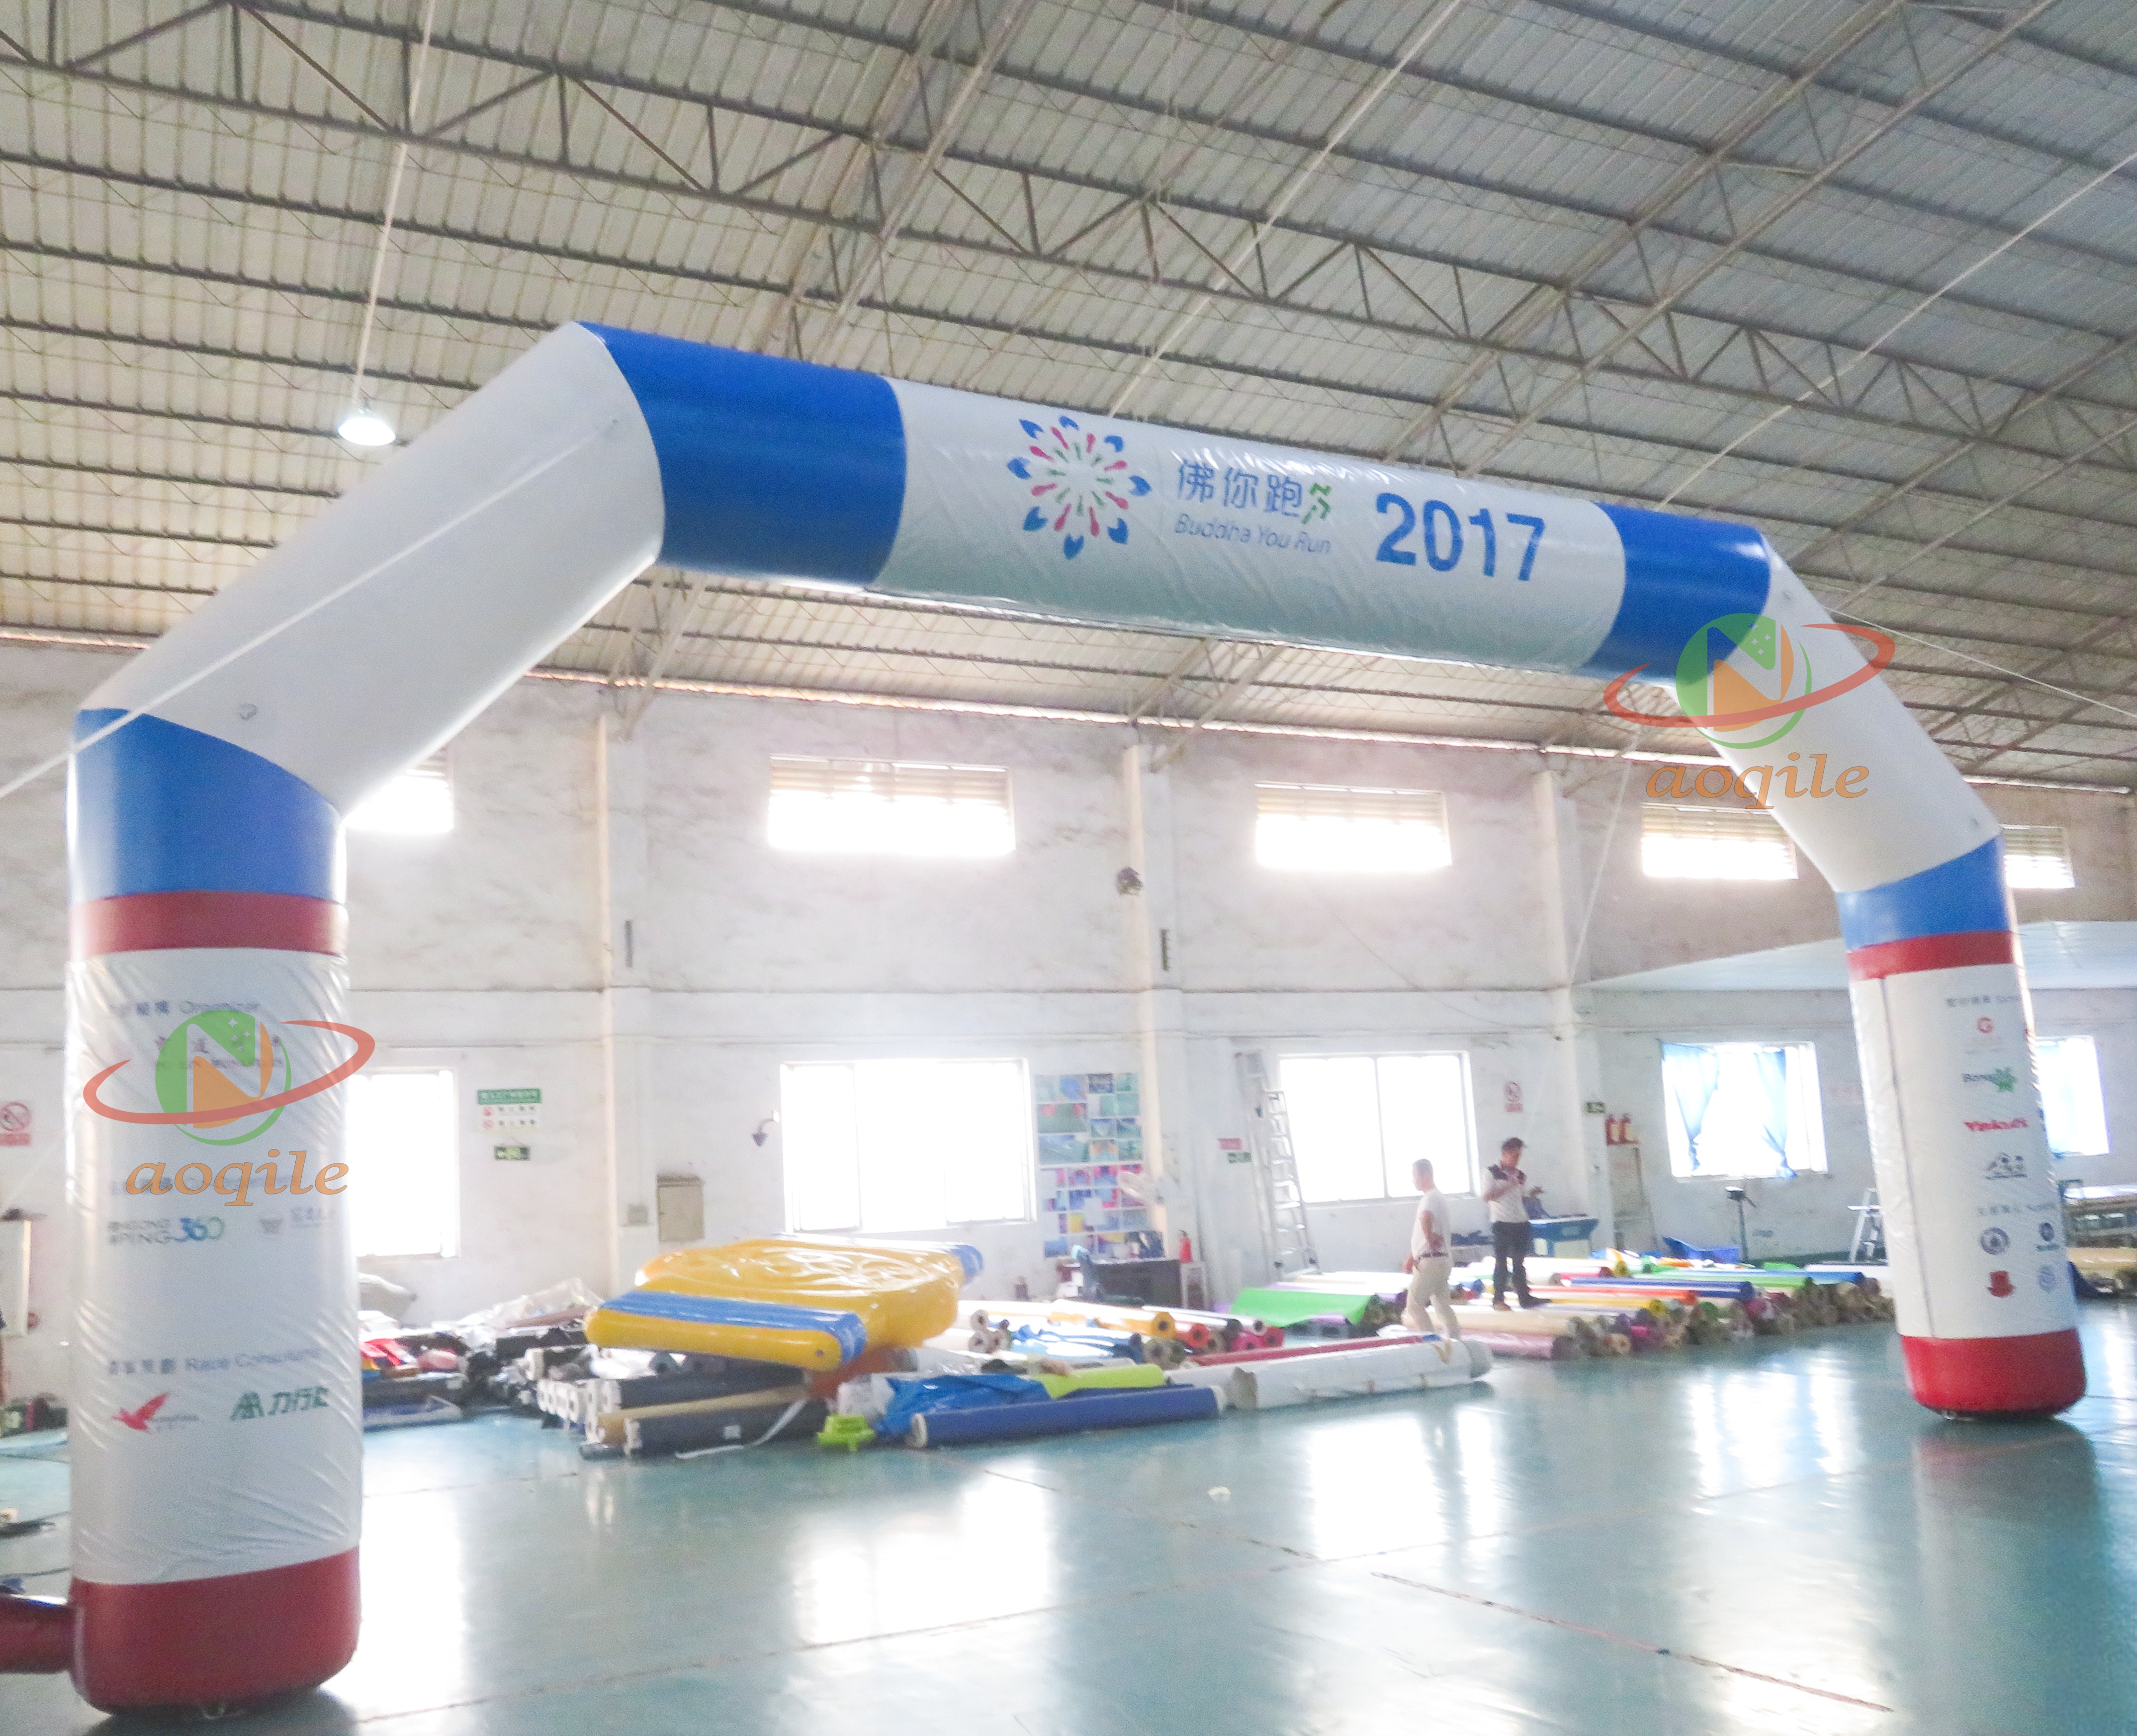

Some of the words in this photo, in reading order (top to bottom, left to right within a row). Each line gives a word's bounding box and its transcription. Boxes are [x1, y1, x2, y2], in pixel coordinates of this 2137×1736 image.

[1176, 458, 1304, 518] 佛你跑
[1173, 513, 1252, 543] Buddha
[1257, 524, 1293, 549] You
[1294, 530, 1332, 554] Run
[1375, 491, 1546, 582] 2017
